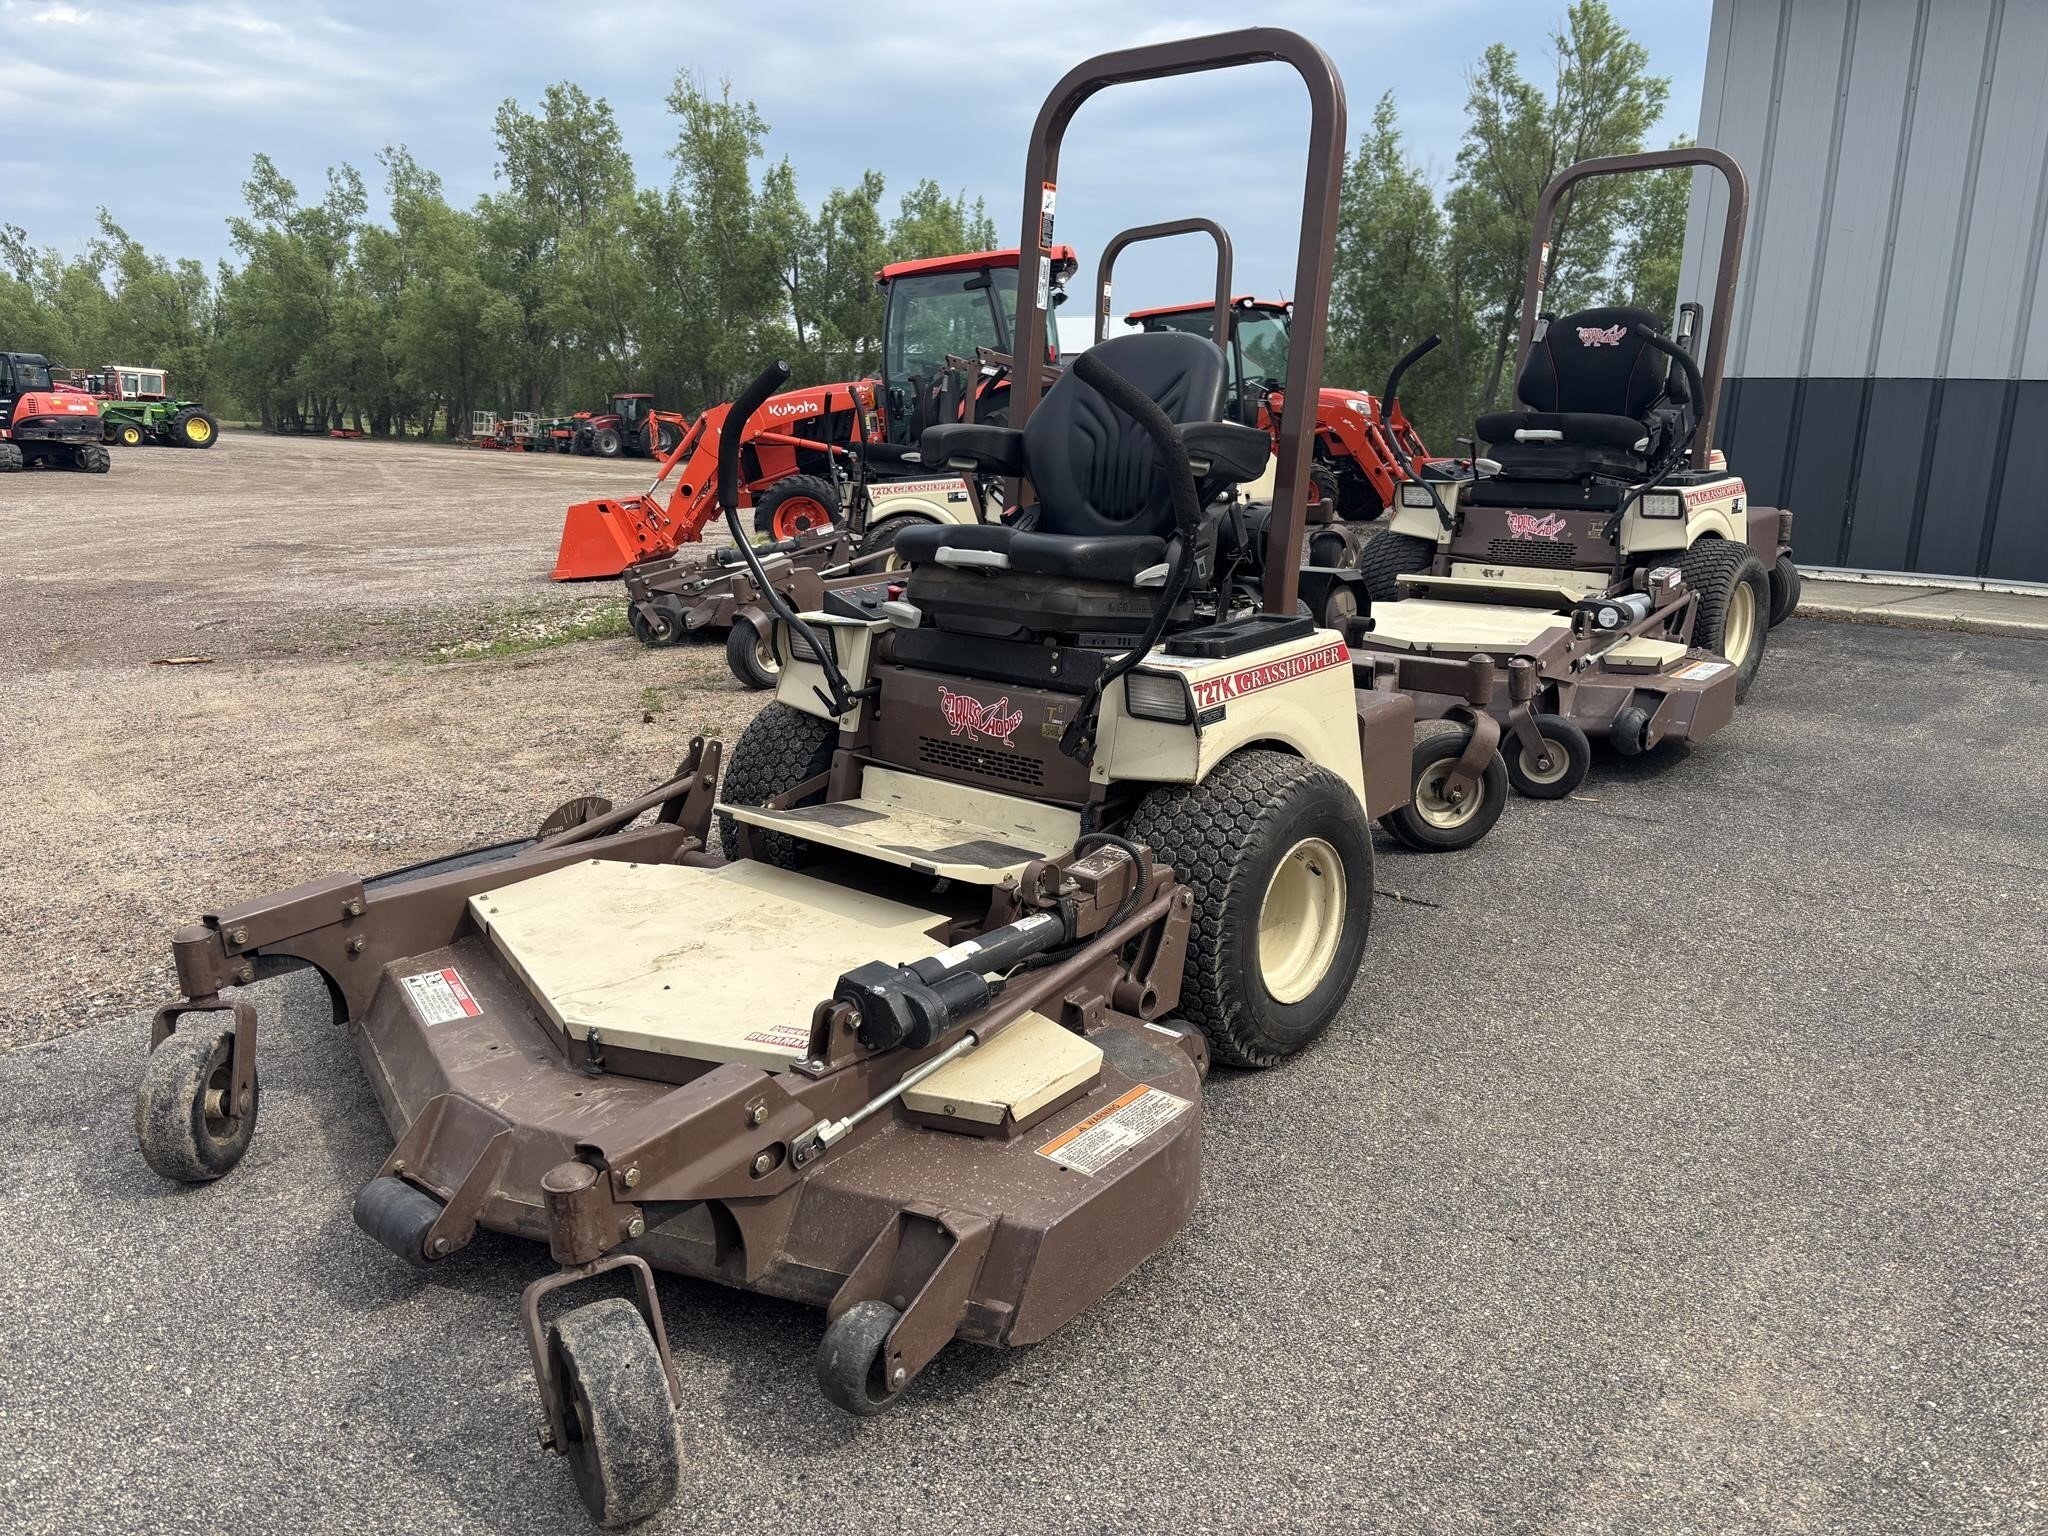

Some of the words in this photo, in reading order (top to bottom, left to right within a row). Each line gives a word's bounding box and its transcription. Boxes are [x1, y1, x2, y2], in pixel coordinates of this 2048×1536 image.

[769, 401, 818, 416] Kubota
[896, 482, 961, 495] GRASSHOPPER
[1193, 675, 1236, 706] 727K
[1239, 646, 1341, 691] GRASSHOPPER
[1086, 1103, 1121, 1127] WARNING
